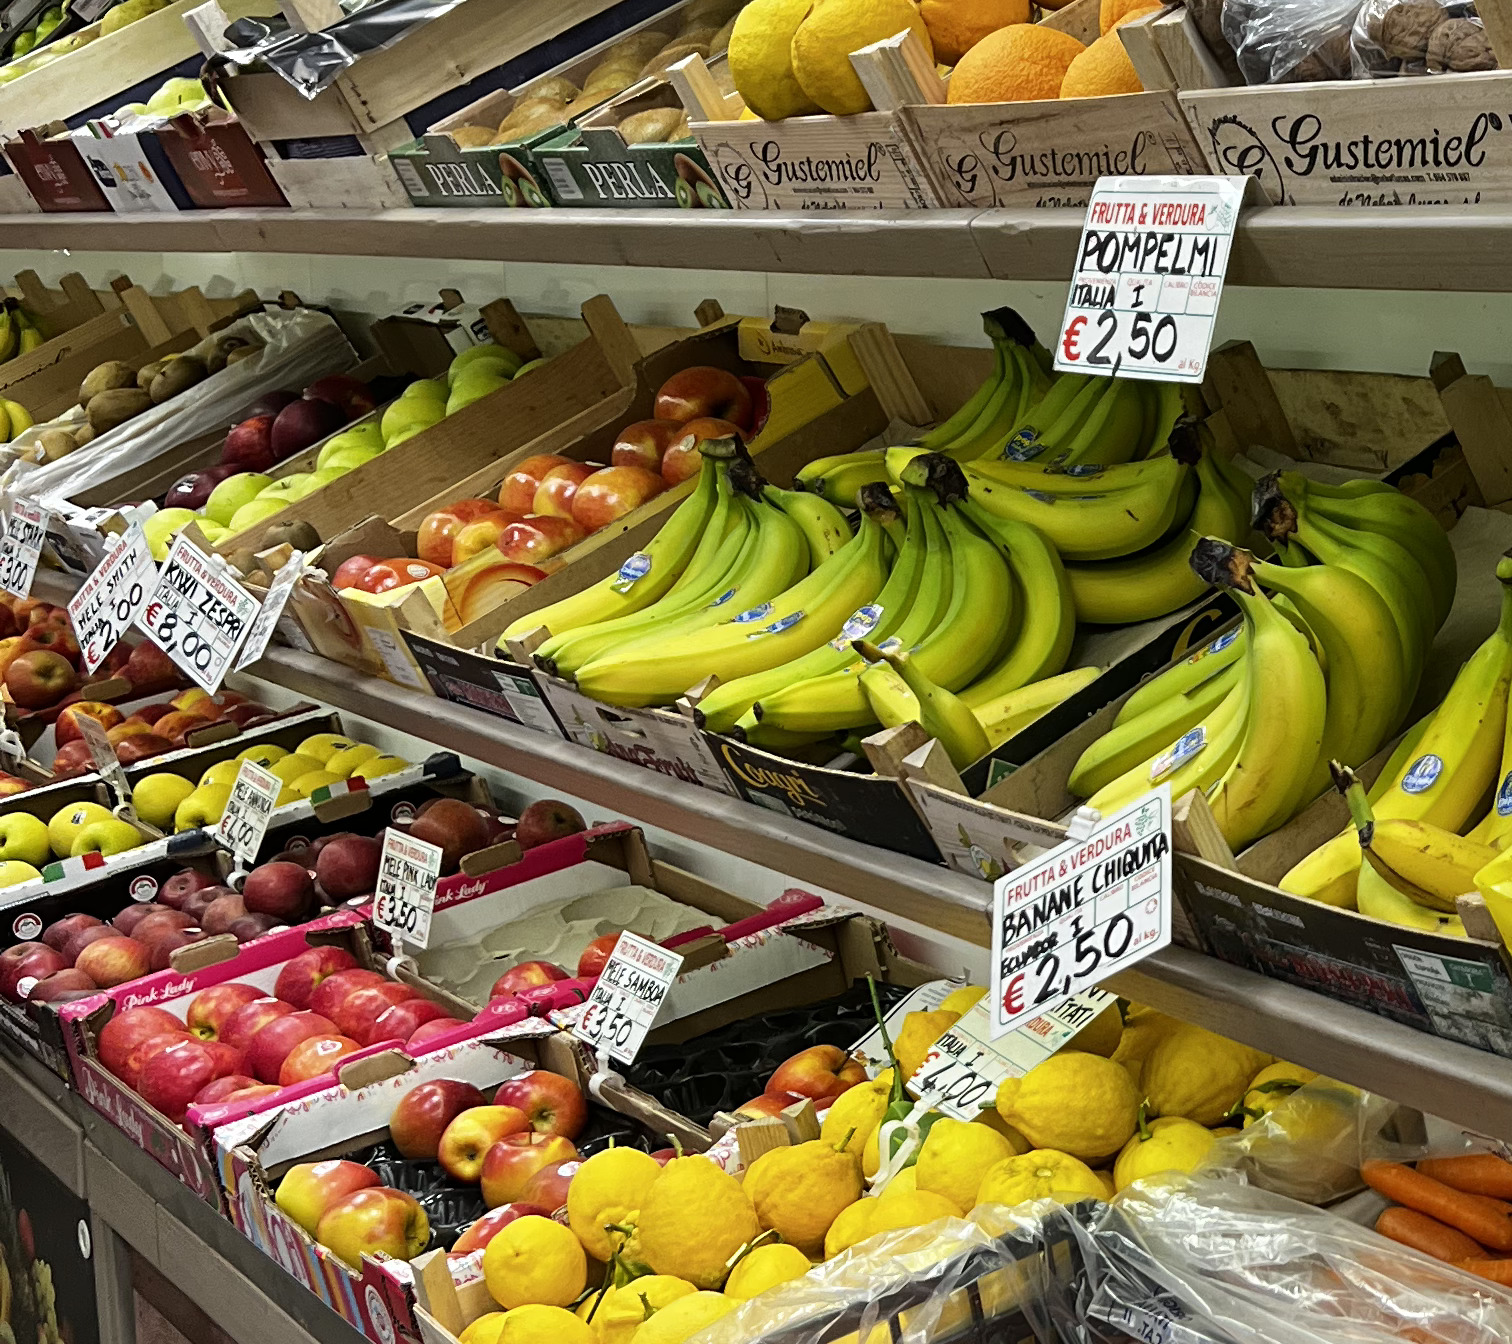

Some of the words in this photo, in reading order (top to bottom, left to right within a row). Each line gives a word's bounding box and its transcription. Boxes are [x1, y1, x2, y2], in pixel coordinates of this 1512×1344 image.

[750, 140, 881, 186] Gustemiel
[979, 130, 1148, 183] Gustemiel
[1272, 113, 1487, 177] Gustemiel
[425, 162, 502, 195] PERLA
[582, 161, 675, 199] PERLA
[1091, 202, 1135, 225] FRUTTA
[1138, 203, 1148, 225] &
[1152, 203, 1206, 226] VERDURA
[1078, 230, 1218, 277] POMPELMI
[1071, 284, 1116, 308] ITALIA
[70, 586, 94, 615] FRUTTA
[98, 540, 128, 578] VERDURA
[78, 591, 103, 632] MELE
[107, 548, 137, 595] SMITH
[157, 585, 180, 613] ITALIA
[177, 546, 201, 575] FRUTTA
[207, 574, 238, 607] VERDURA
[164, 560, 198, 600] KIWI
[199, 590, 246, 643] ZESPRI
[1008, 869, 1056, 906] FRUTTA
[1058, 860, 1068, 878] &
[1070, 823, 1132, 871] VERDURA
[435, 888, 455, 906] ink
[455, 879, 489, 900] Lady
[1003, 875, 1085, 946] BANANE
[1092, 832, 1169, 895] CHIQUITA
[121, 986, 159, 1011] Pink
[160, 977, 194, 999] Lady
[602, 958, 627, 987] MELE
[624, 970, 666, 1005] SAMBOA
